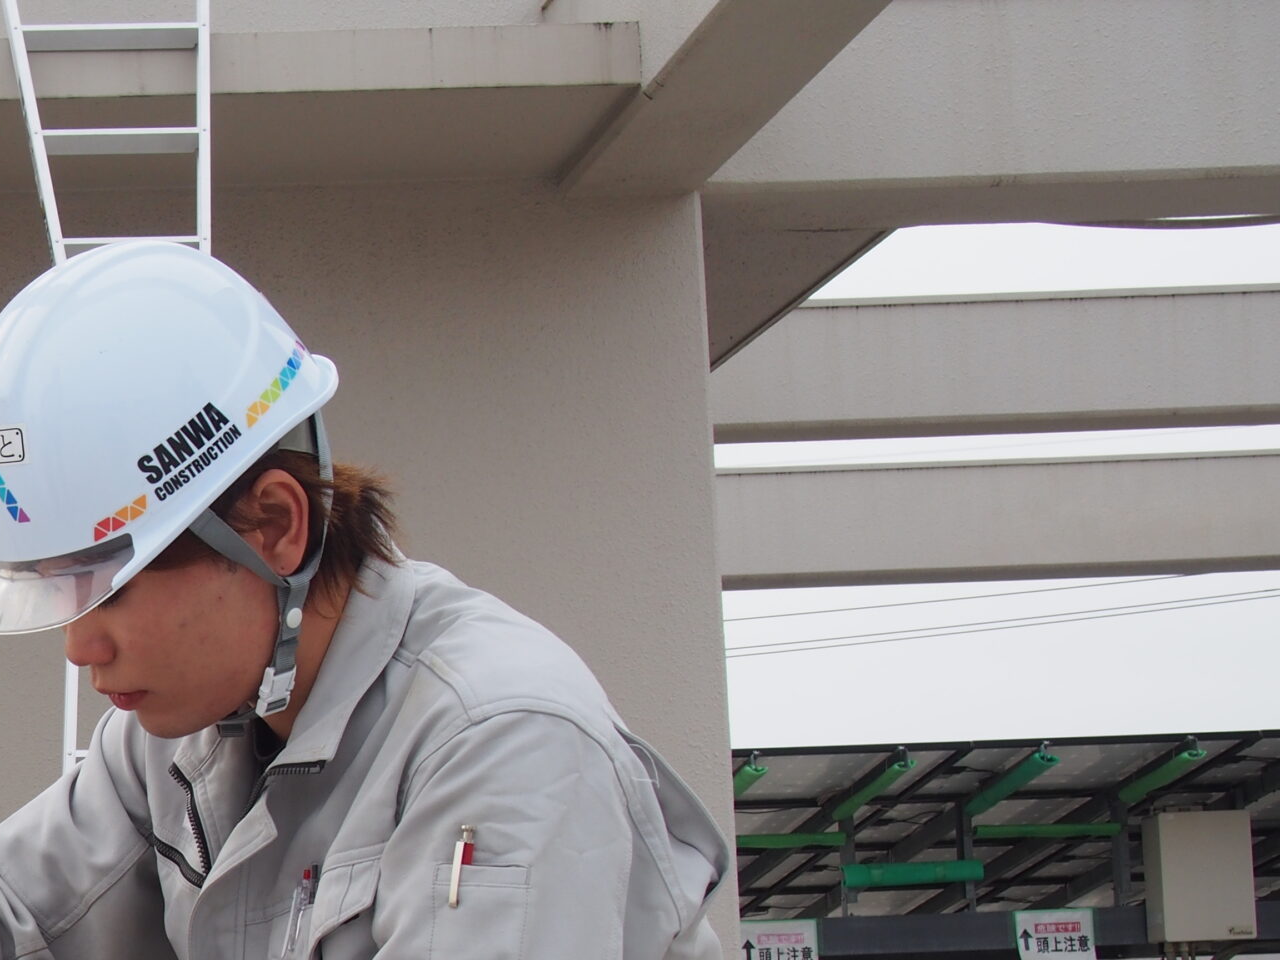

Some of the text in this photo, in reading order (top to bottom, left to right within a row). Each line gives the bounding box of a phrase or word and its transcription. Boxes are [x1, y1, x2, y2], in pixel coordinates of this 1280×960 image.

[137, 401, 231, 484] SANWA
[154, 423, 242, 502] CONSTRUCTION
[1035, 935, 1090, 953] 頭上注意
